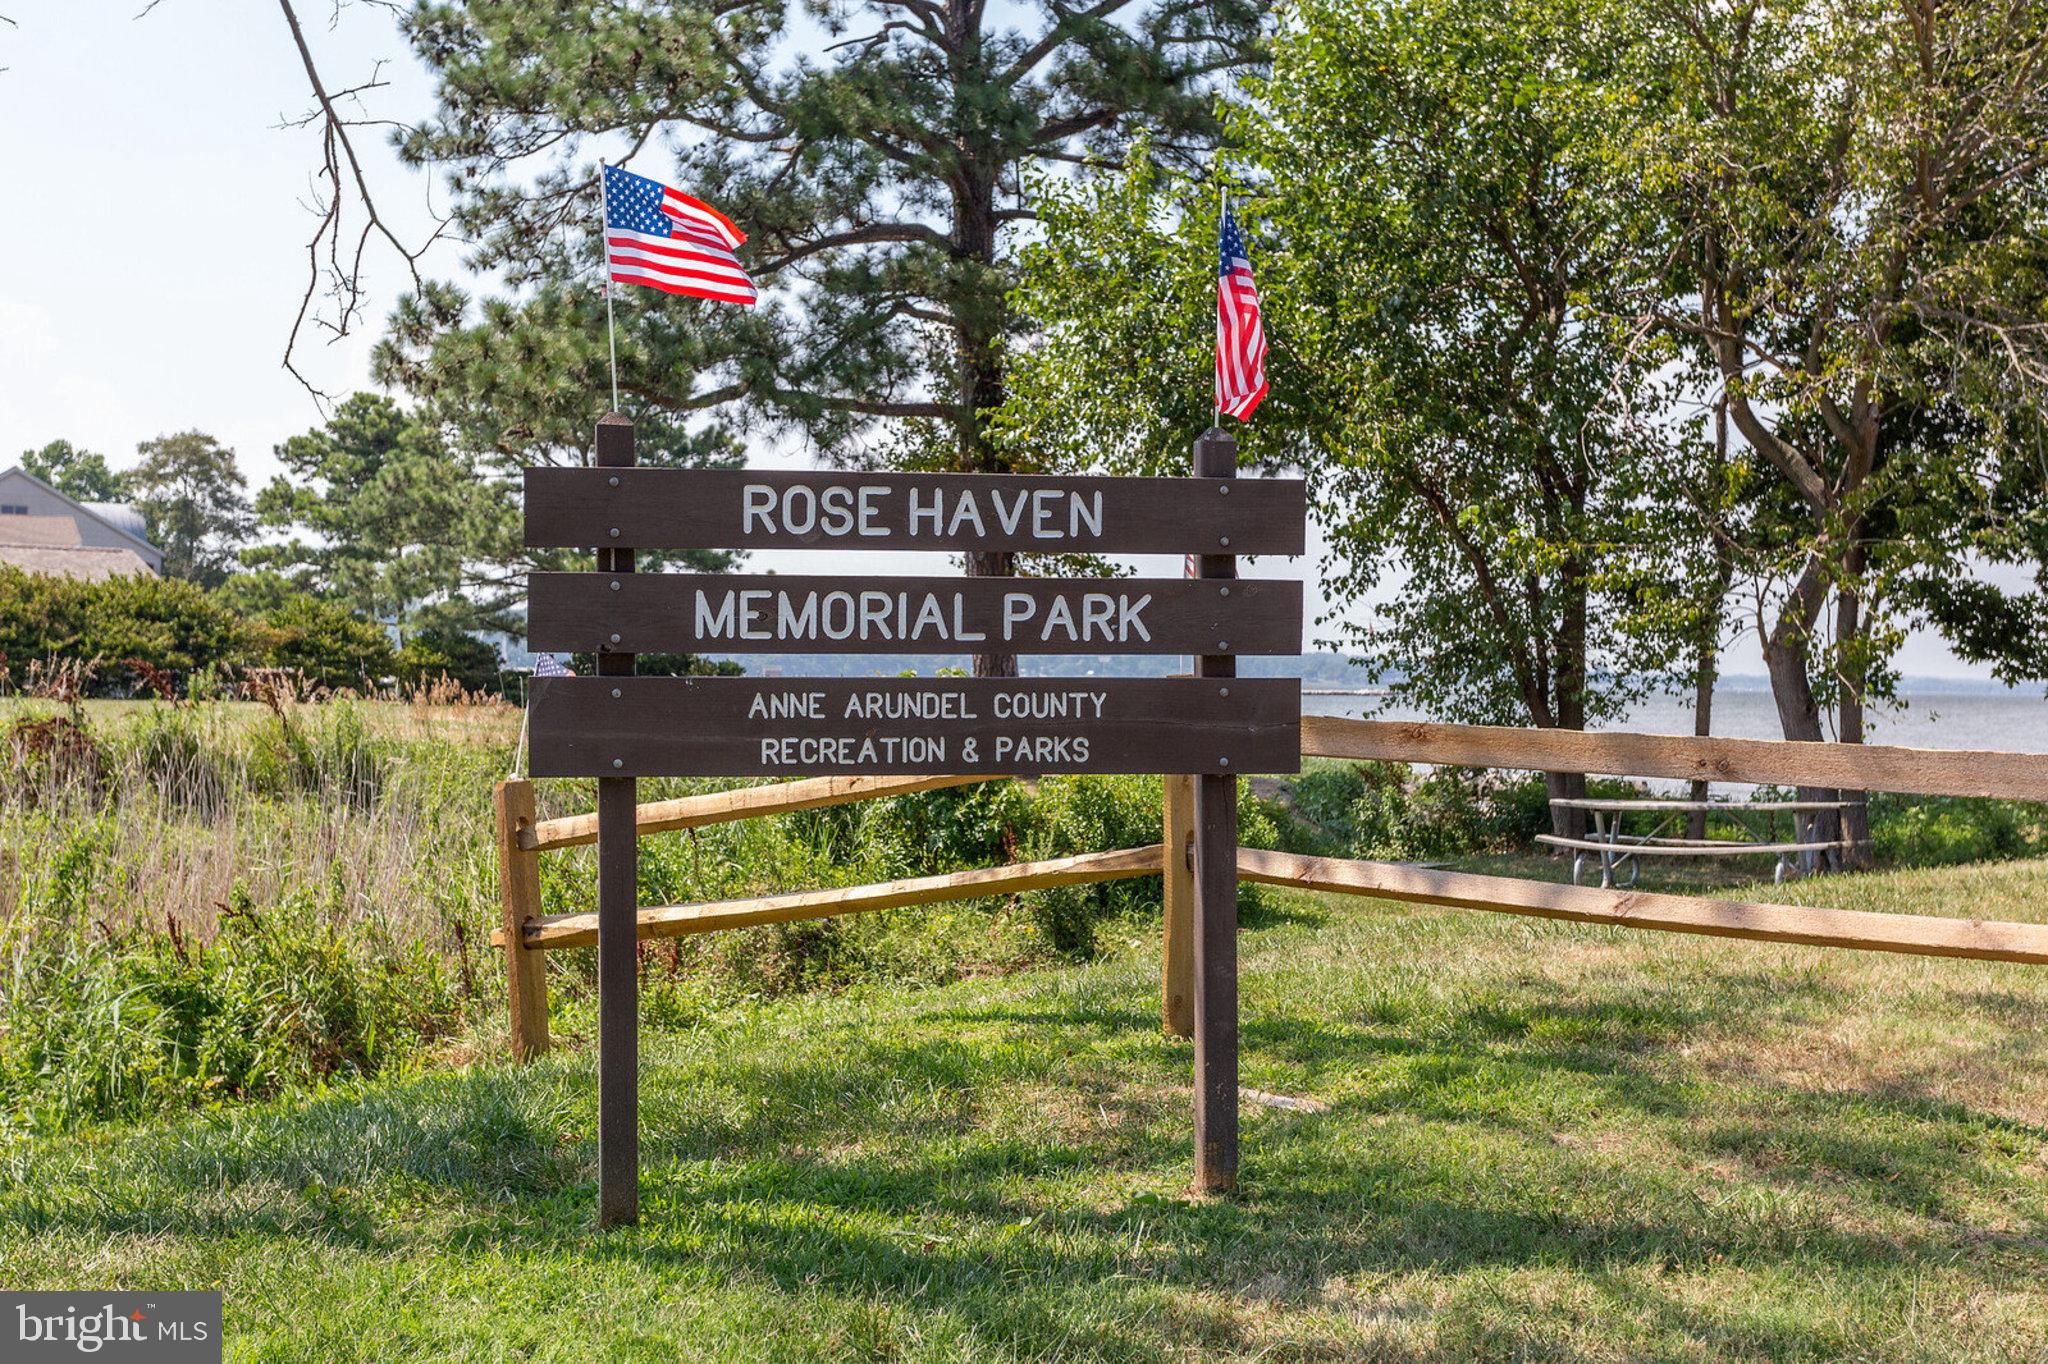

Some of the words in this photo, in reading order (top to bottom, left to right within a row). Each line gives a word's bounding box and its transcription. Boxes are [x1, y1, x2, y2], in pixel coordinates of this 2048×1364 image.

[742, 484, 893, 537] ROSE
[908, 487, 1104, 539] HAVEN
[694, 589, 987, 642] MEMORIAL
[1003, 592, 1153, 643] PARK
[748, 692, 826, 720] ANNE
[844, 691, 977, 719] ARUNDEL
[993, 692, 1107, 719] COUNTY
[761, 737, 945, 765] RECREATION
[962, 737, 979, 763] &
[995, 736, 1090, 762] PARKS
